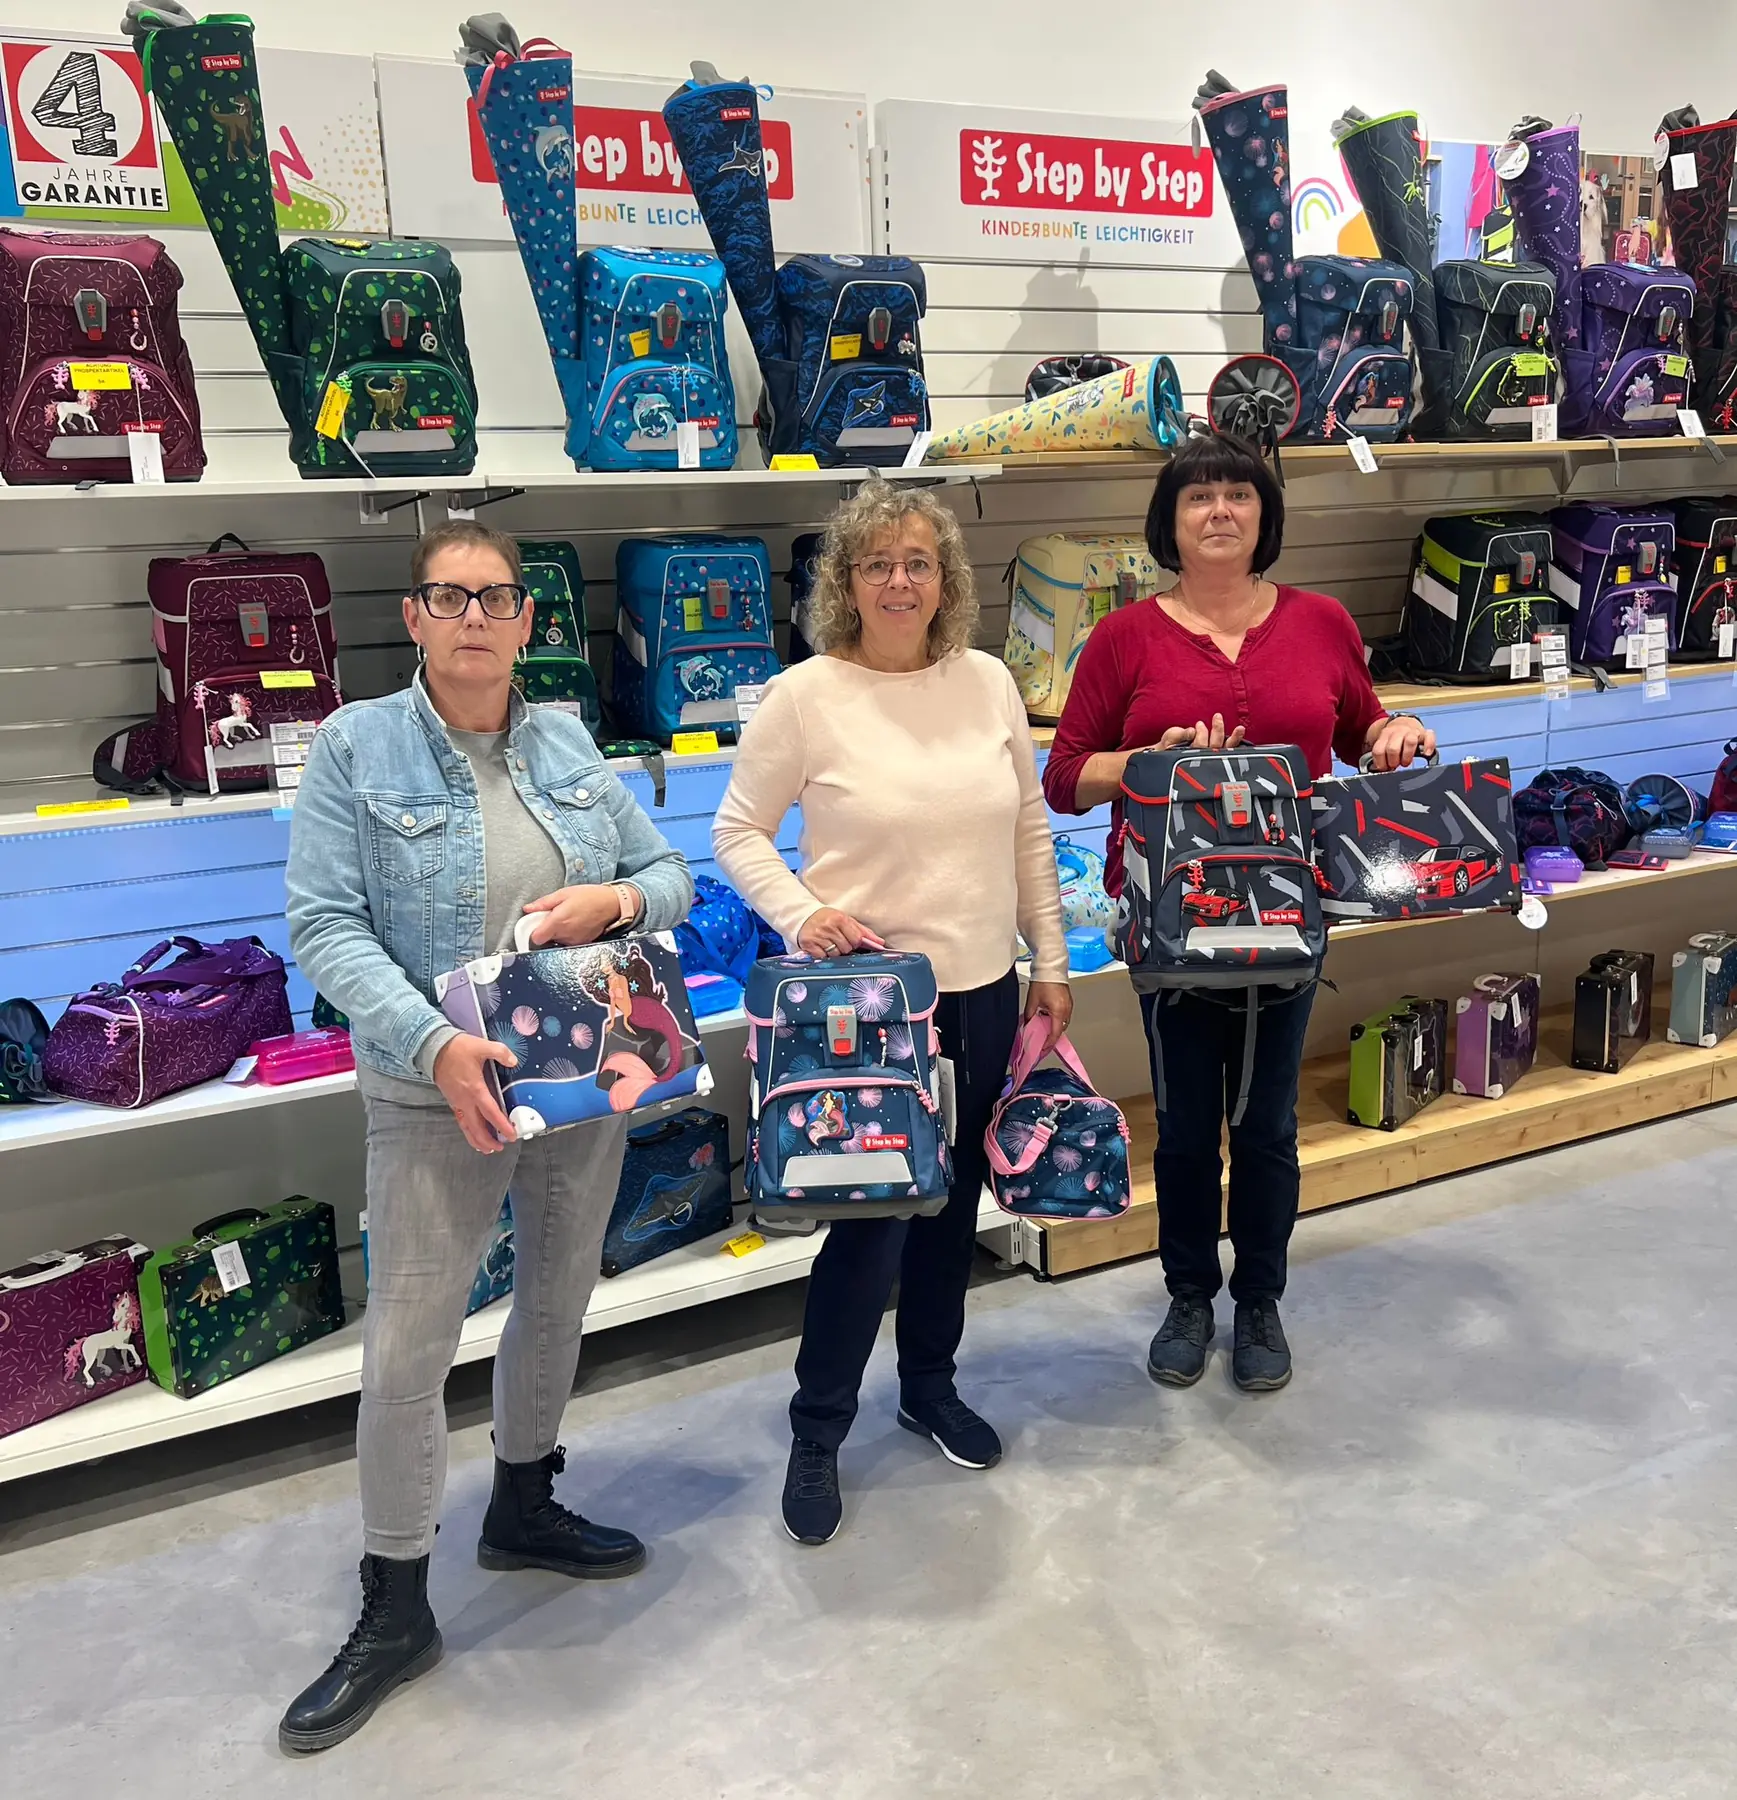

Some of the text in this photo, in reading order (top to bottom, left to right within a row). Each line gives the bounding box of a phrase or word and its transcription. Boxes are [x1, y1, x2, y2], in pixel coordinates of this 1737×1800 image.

[31, 51, 118, 157] 4
[574, 120, 683, 188] ep by
[53, 167, 128, 183] JAHRE
[1016, 142, 1204, 210] Step by Step
[20, 181, 164, 207] GARANTIE
[981, 219, 1194, 245] KINDERBUNTE LEICHTIGKEIT
[1270, 911, 1299, 921] Step by Step
[872, 1137, 905, 1146] Step by Step
